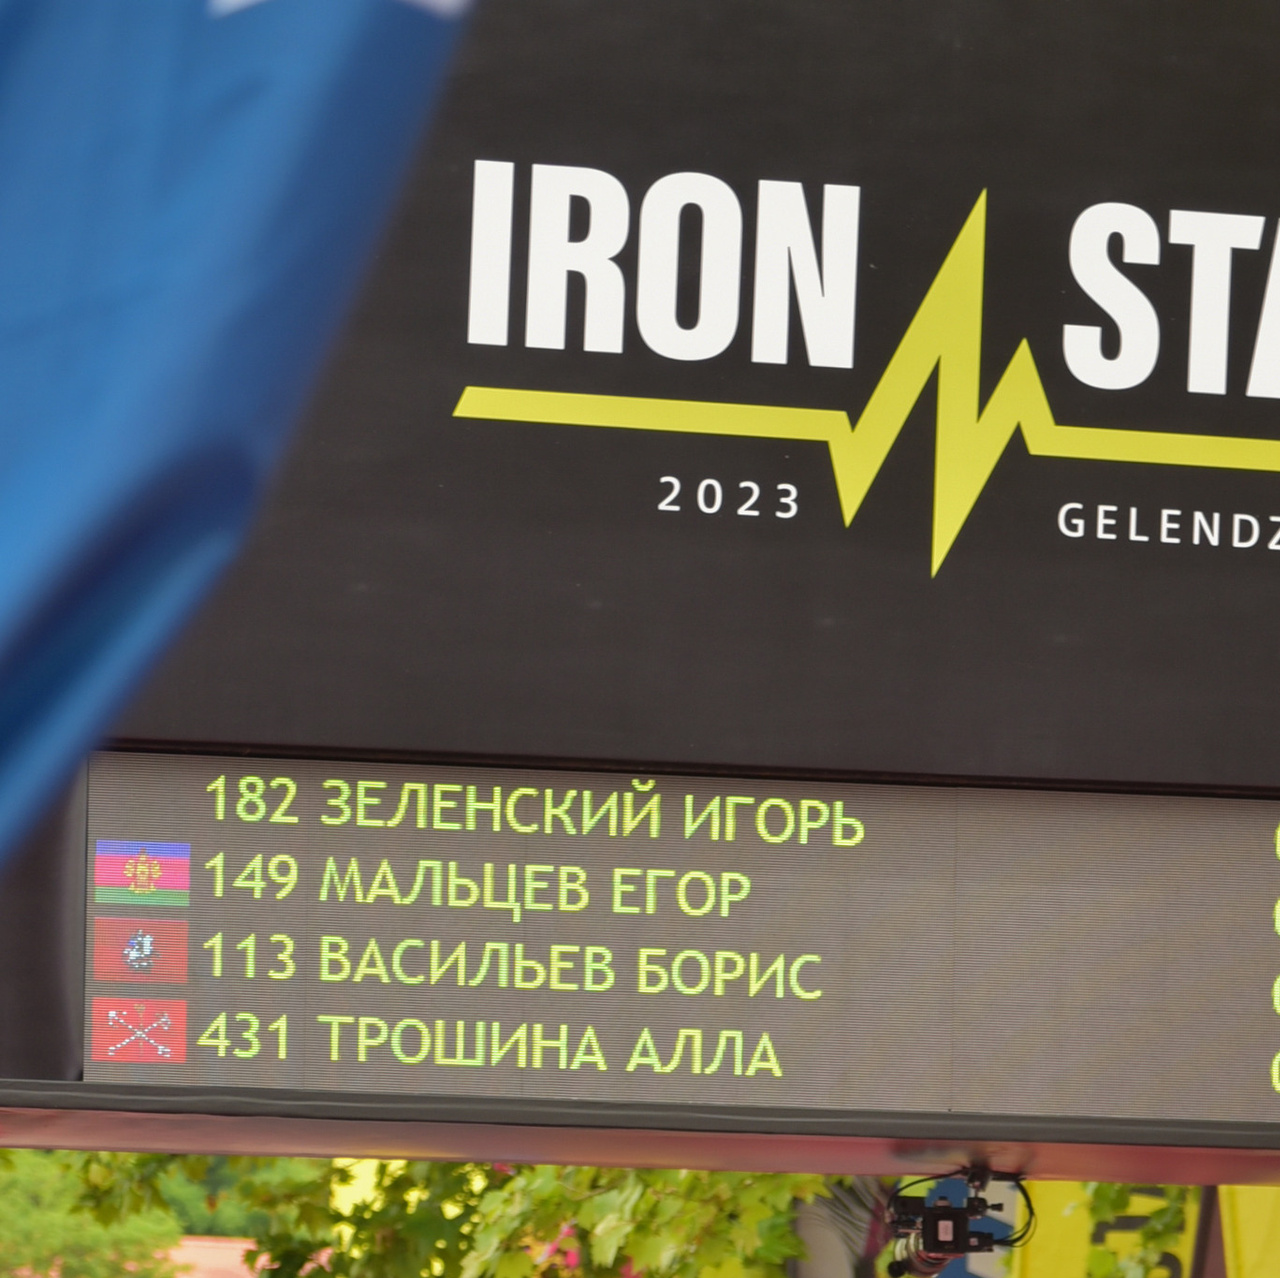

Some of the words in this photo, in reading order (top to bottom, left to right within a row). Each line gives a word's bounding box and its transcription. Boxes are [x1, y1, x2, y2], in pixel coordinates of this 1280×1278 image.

[468, 159, 860, 369] IRON
[657, 475, 801, 518] 2023
[205, 775, 300, 825] 182
[320, 779, 662, 838] ЗЕЛЕНСКИЙ
[684, 795, 866, 847] ИГОРЬ
[202, 852, 300, 900] 149
[319, 855, 590, 922] МАЛЬЦЕВ
[613, 868, 752, 917] ЕГОР
[201, 932, 297, 981] 113
[318, 935, 616, 992] ВАСИЛЬЕВ
[637, 949, 824, 1000] БОРИС
[196, 1012, 291, 1060] 431
[317, 1014, 607, 1071] ТРОШИНА
[626, 1027, 784, 1078] АЛЛА
